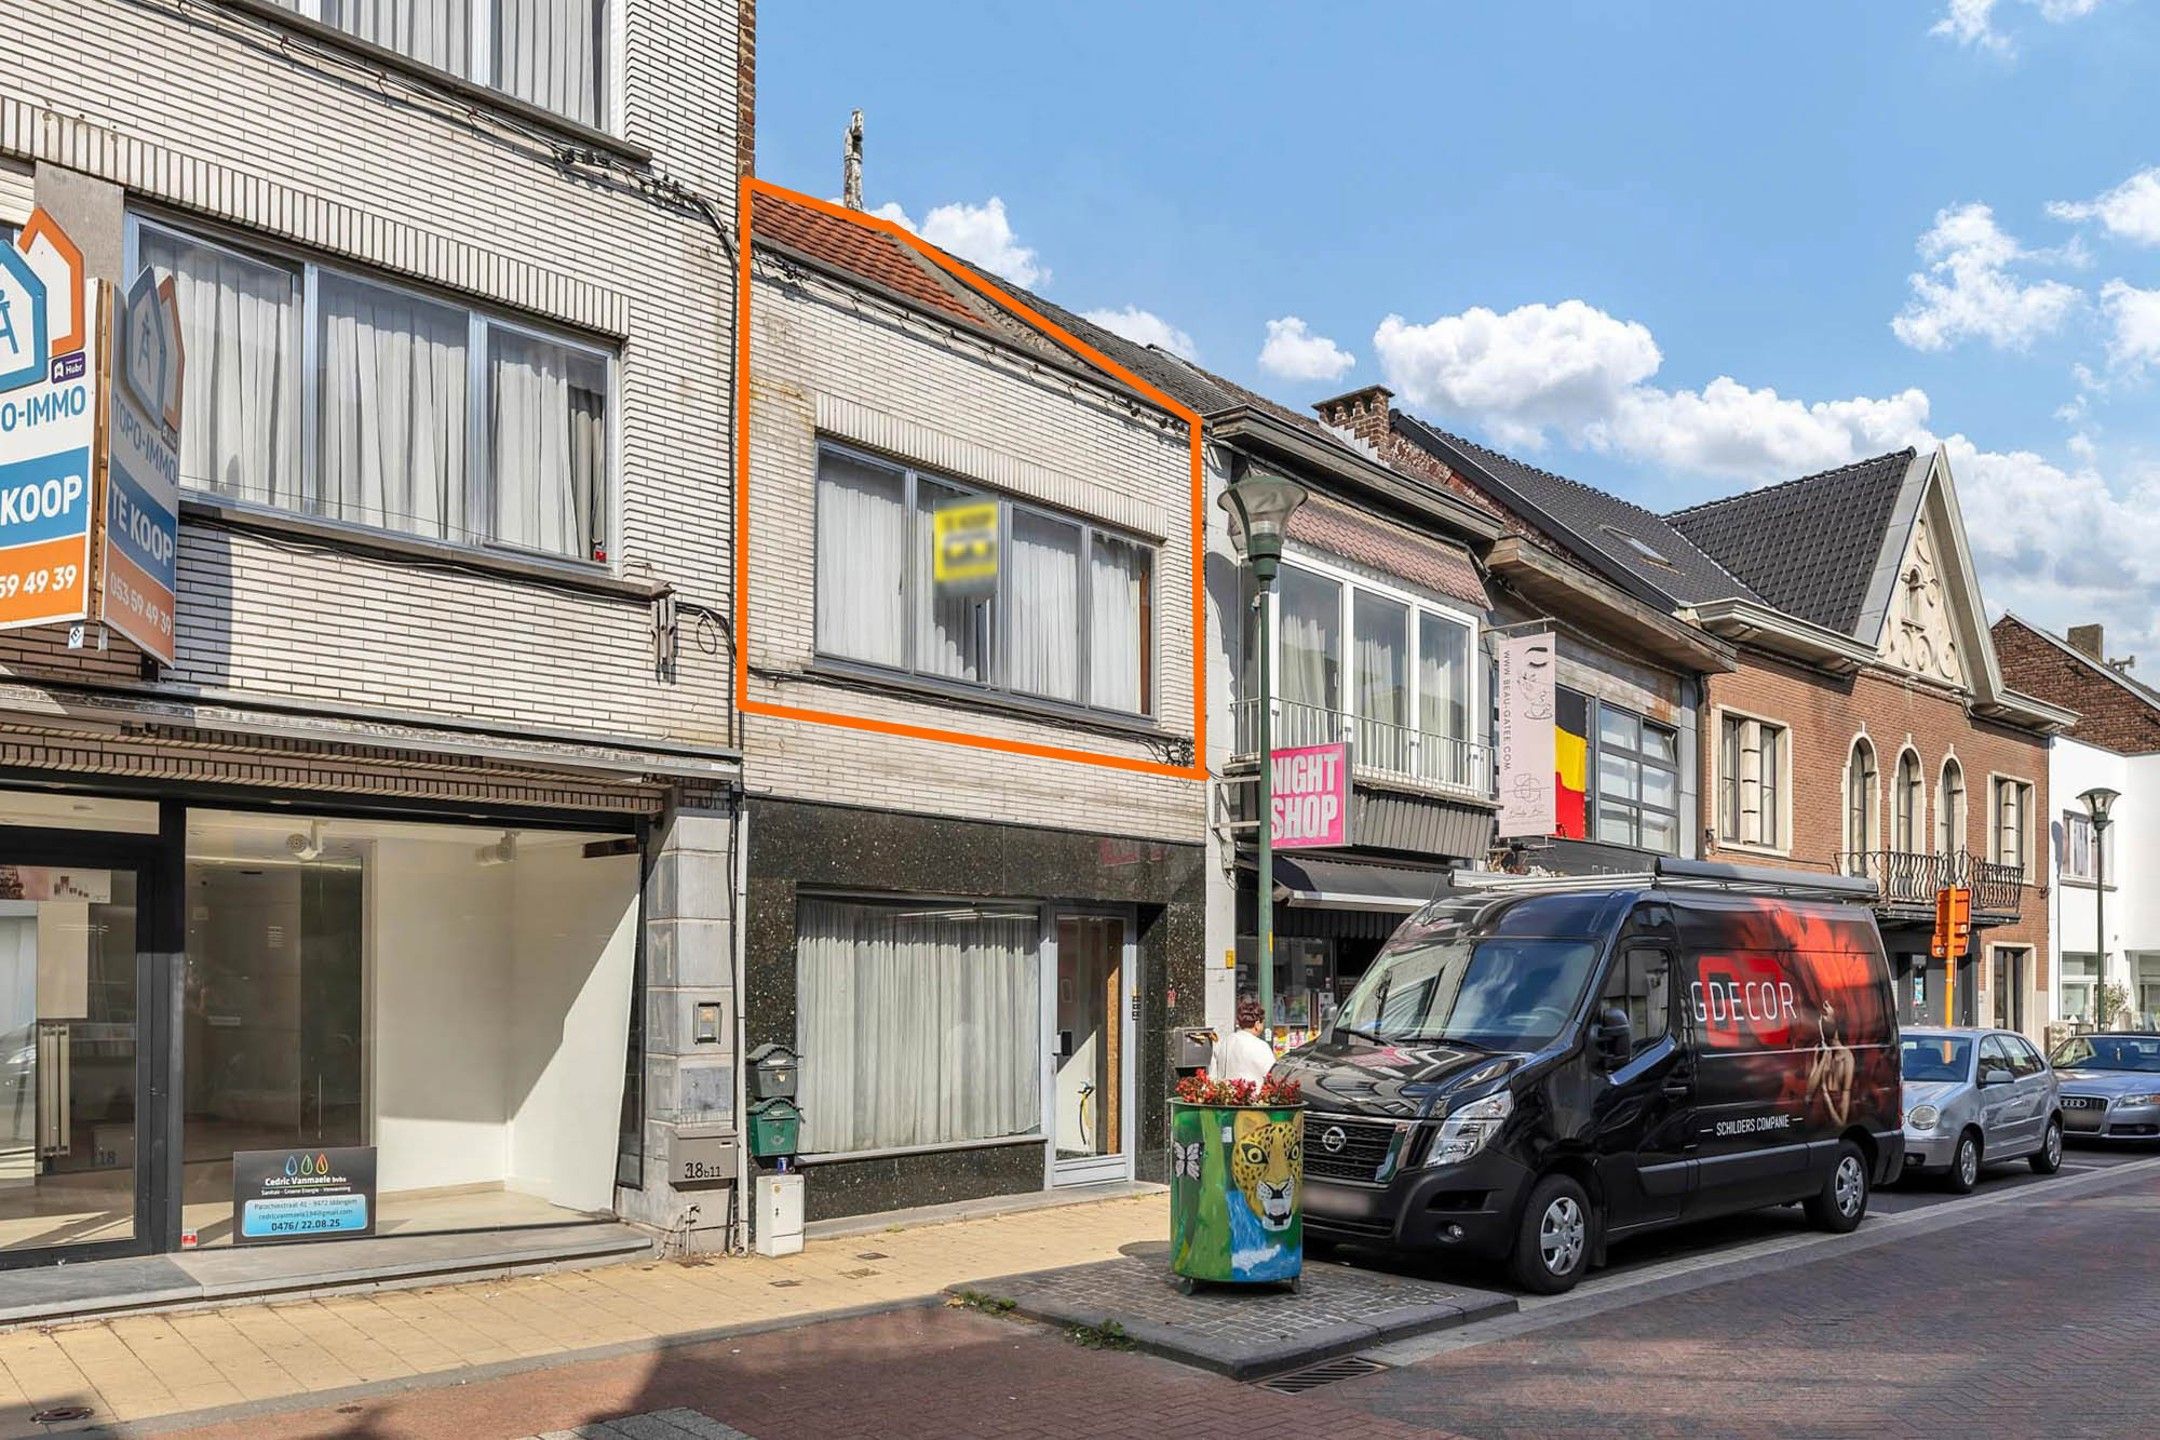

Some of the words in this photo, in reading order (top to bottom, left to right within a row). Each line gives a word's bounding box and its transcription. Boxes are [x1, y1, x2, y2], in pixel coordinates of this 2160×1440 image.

[115, 393, 176, 486] TOPO-IMMO
[0, 474, 83, 527] KOOP
[111, 480, 127, 533] TE
[130, 502, 173, 567] KOOP
[23, 569, 49, 595] 49
[52, 563, 77, 592] 39
[110, 570, 129, 606] 053
[130, 589, 144, 617] 59
[146, 602, 159, 625] 49
[160, 611, 172, 637] 39
[1271, 752, 1341, 795] NIGHT
[1271, 794, 1338, 840] SHOP
[1690, 981, 1797, 1022] GDECOR
[1716, 1118, 1755, 1136] SCHILDERS
[1756, 1114, 1790, 1131] COMPANIE
[264, 1177, 291, 1186] Cedric
[291, 1175, 331, 1185] Vanmaele
[271, 1221, 299, 1232] 0476/
[301, 1218, 340, 1230] 22.08.25
